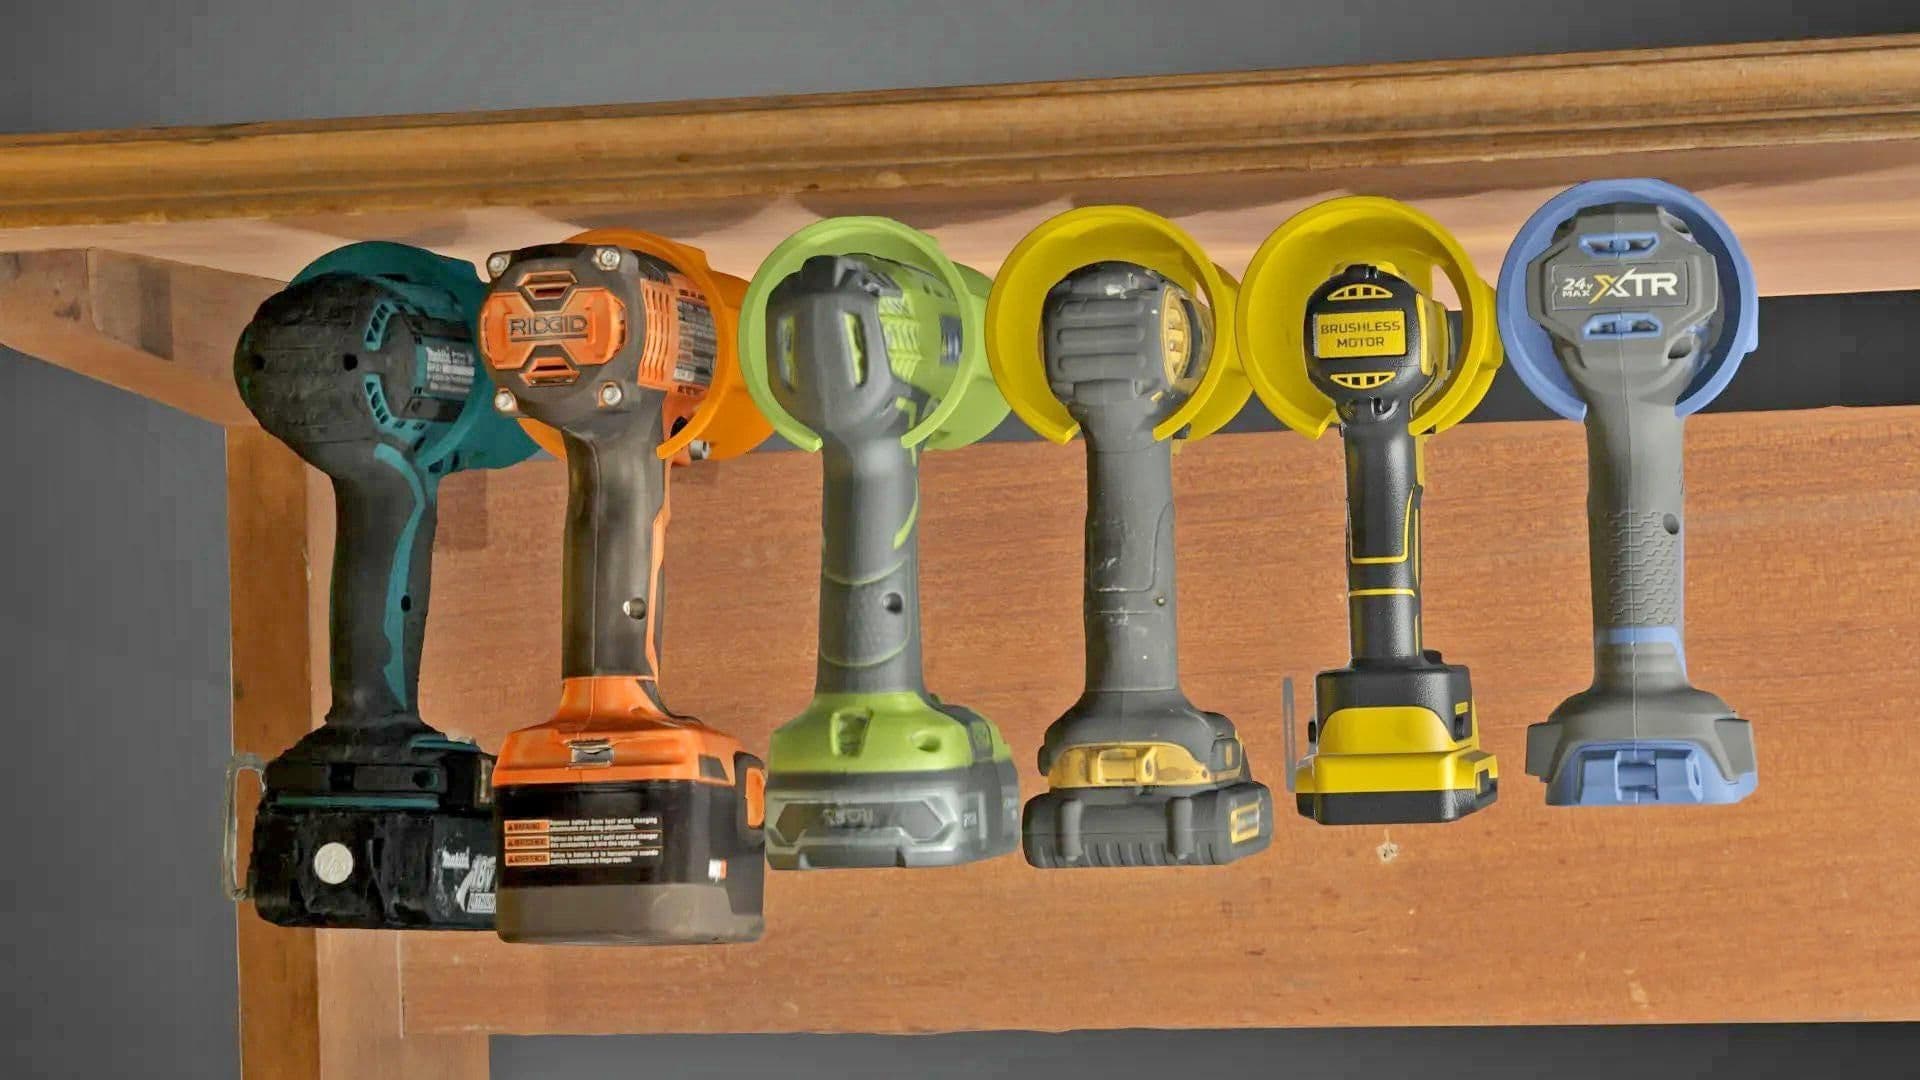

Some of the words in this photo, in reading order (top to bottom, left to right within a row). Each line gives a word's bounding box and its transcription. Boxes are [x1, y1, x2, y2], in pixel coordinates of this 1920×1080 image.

[1589, 264, 1678, 305] XTR
[1562, 289, 1591, 298] MAX
[509, 314, 588, 337] RIDGID
[1320, 320, 1401, 335] BRUSHLESS
[1336, 336, 1385, 348] MOTOR
